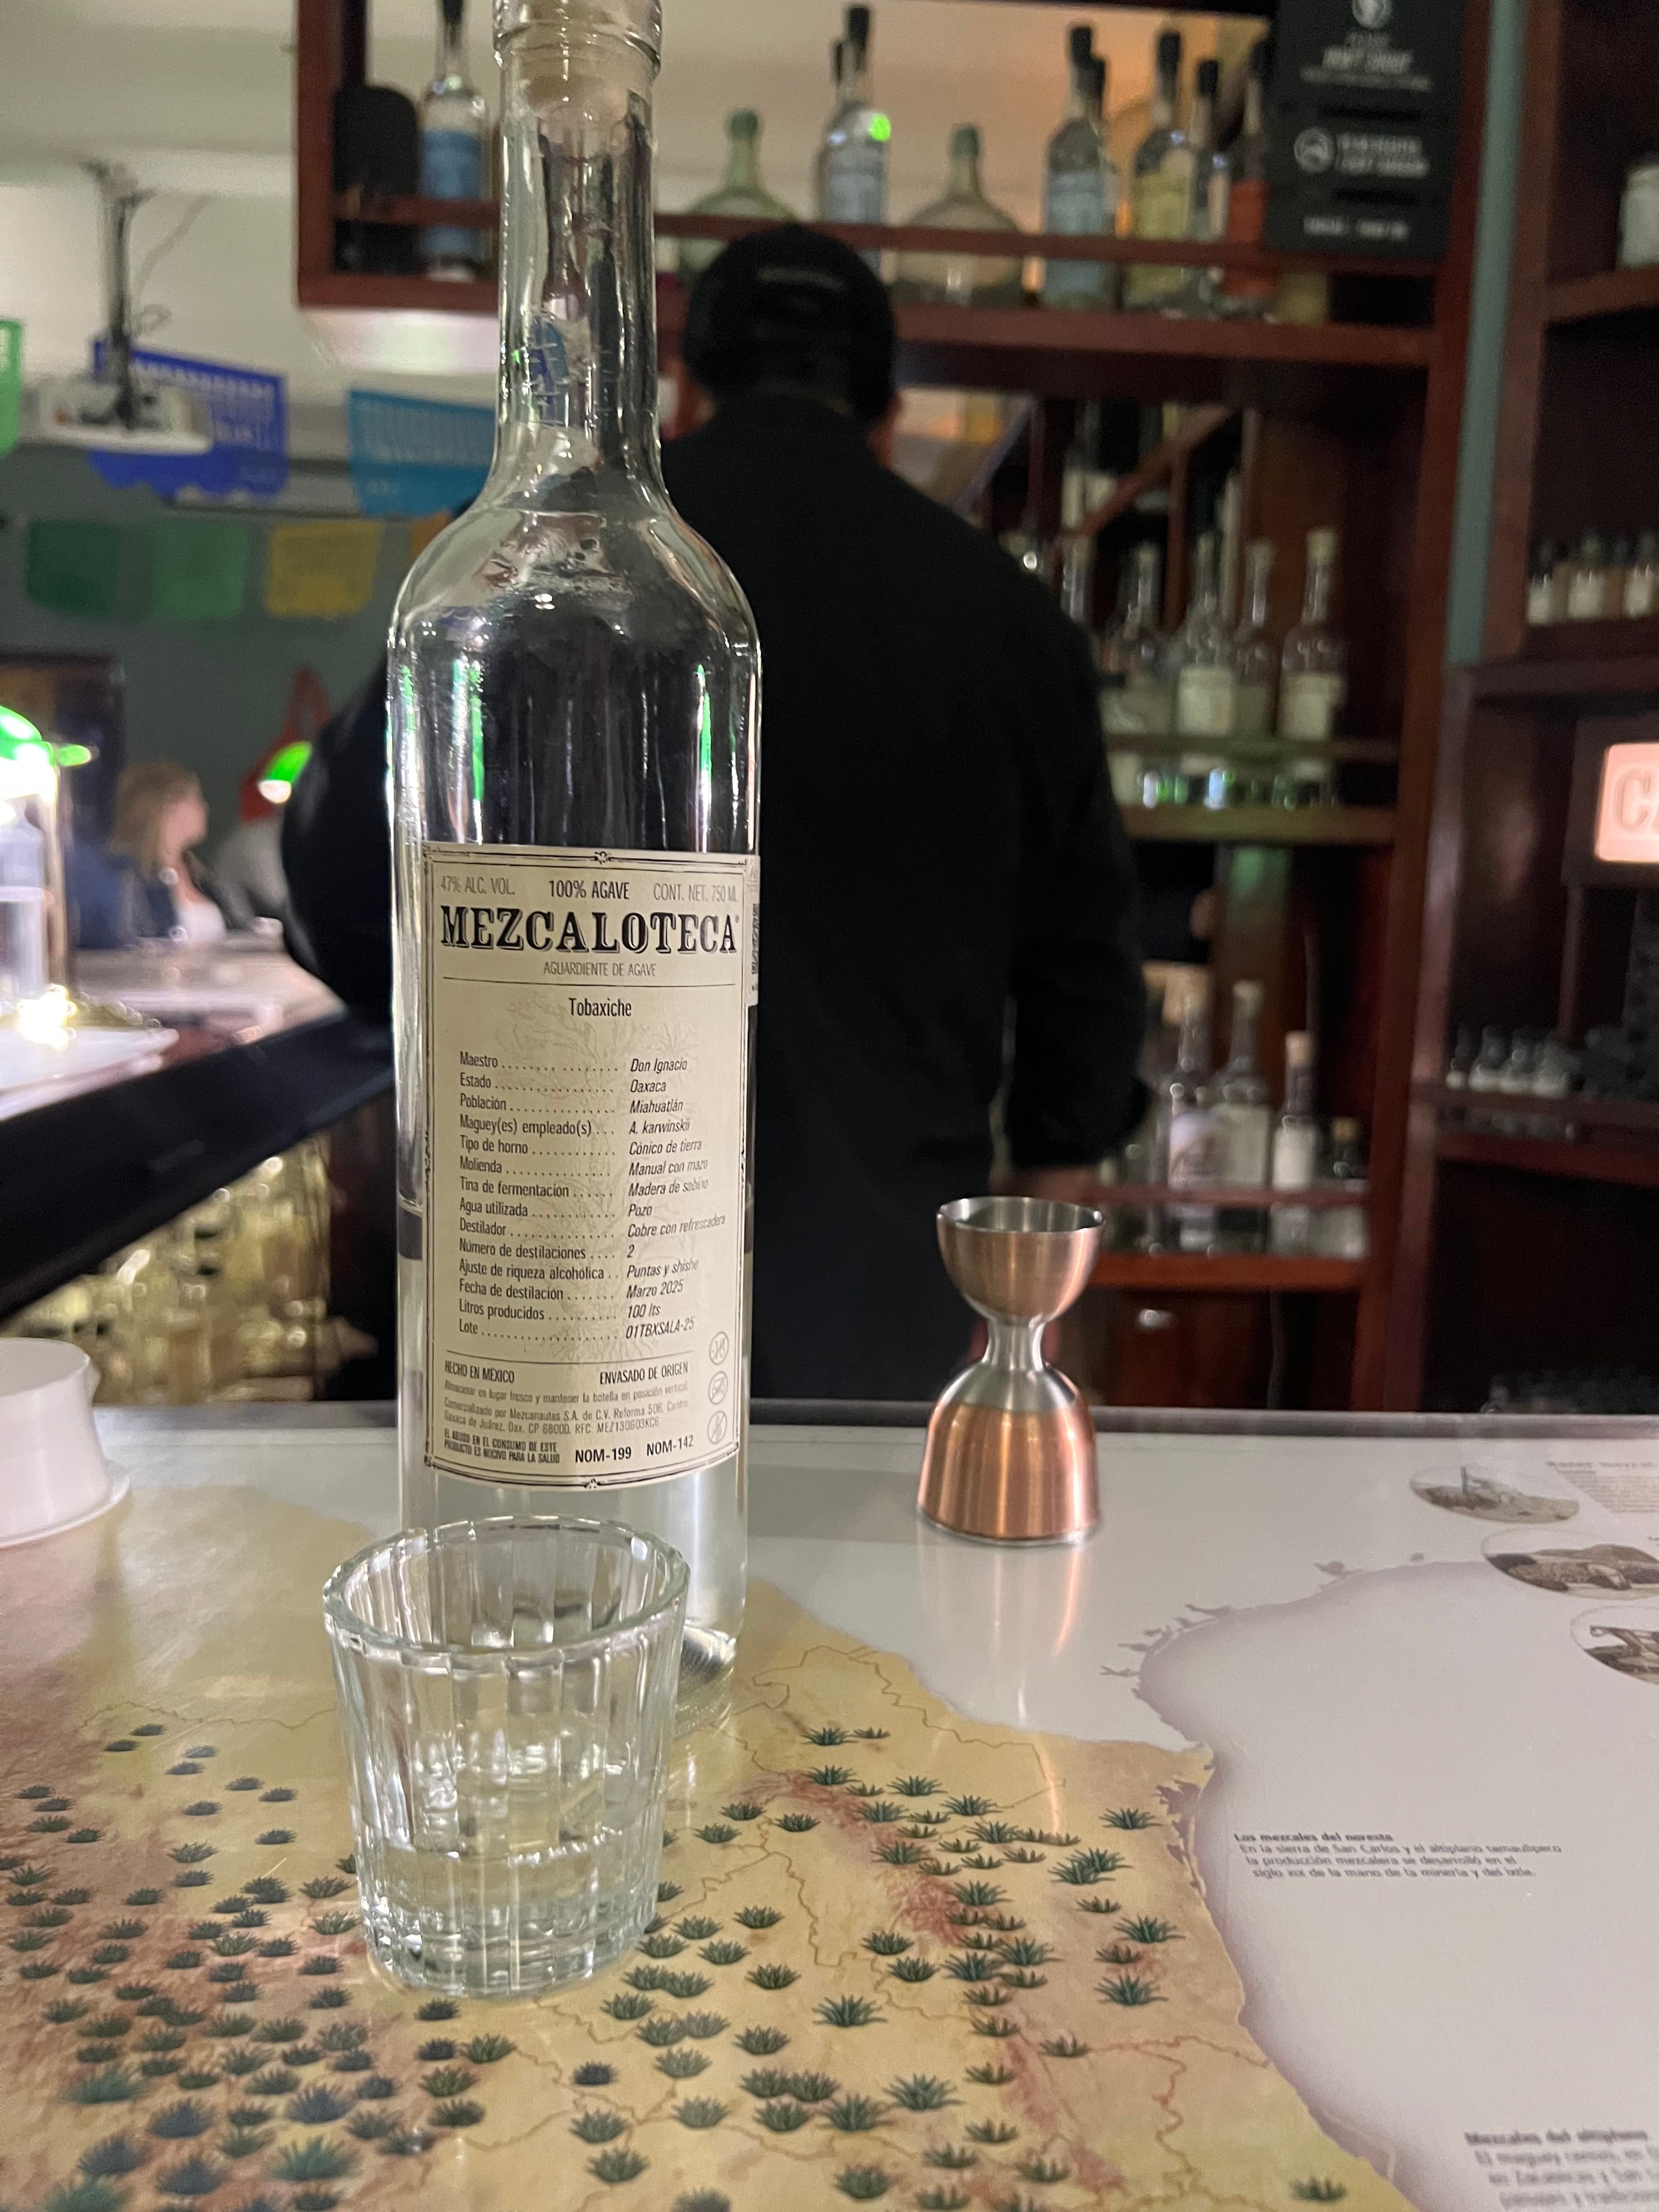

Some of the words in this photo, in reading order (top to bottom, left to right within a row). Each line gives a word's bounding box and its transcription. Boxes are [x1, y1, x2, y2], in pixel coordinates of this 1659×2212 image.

[442, 876, 461, 893] 47%
[492, 878, 515, 895] VOL.
[549, 880, 586, 898] 100%
[592, 881, 630, 900] AGAVE
[653, 883, 685, 901] CONT.
[689, 884, 708, 902] NET.
[712, 885, 726, 902] 750
[727, 886, 737, 902] ML
[441, 905, 737, 955] MEZCALOTECA
[544, 961, 608, 977] AGUARDIENTE
[612, 962, 624, 977] DE
[628, 963, 657, 977] AGAVE
[568, 997, 632, 1017] Tobaxiche
[460, 1051, 498, 1068] Maestro
[631, 1058, 650, 1072] Don
[653, 1058, 687, 1074] Ignacio
[460, 1071, 491, 1088] Estado
[630, 1079, 666, 1093] Oaxaca
[630, 1099, 683, 1113] Miahuatlán
[460, 1113, 517, 1136] Maguey(es)
[522, 1120, 591, 1138] empleado(s)
[629, 1121, 638, 1135] A.
[642, 1118, 691, 1134] karwinskii
[460, 1135, 479, 1154] Tipo
[483, 1138, 494, 1152] de
[498, 1139, 528, 1154] horno
[629, 1141, 663, 1155] Cónico
[666, 1139, 677, 1153] de
[680, 1138, 702, 1152] tierra
[460, 1155, 502, 1173] Molienda
[629, 1161, 666, 1176] Manual
[668, 1163, 685, 1173] con
[687, 1159, 708, 1172] mazo
[460, 1176, 478, 1192] Tina
[483, 1180, 494, 1194] de
[629, 1182, 665, 1197] Madera
[669, 1180, 680, 1193] de
[460, 1197, 482, 1216] Agua
[486, 1201, 528, 1216] utilizada
[628, 1203, 652, 1217] Pozo
[460, 1217, 506, 1236] Destilador
[628, 1223, 657, 1238] Cobre
[660, 1223, 676, 1235] con
[460, 1238, 495, 1255] Número
[500, 1243, 512, 1257] de
[516, 1244, 586, 1260] destilaciones
[627, 1244, 635, 1258] 2
[460, 1258, 487, 1276] Ajuste
[490, 1263, 503, 1277] de
[506, 1265, 545, 1282] riqueza
[550, 1266, 604, 1280] alcohólica
[627, 1265, 661, 1278] Puntas
[663, 1267, 669, 1277] y
[672, 1259, 699, 1273] shishe
[460, 1278, 487, 1295] Fecha
[490, 1283, 502, 1297] de
[506, 1285, 563, 1300] destilación
[627, 1284, 657, 1299] Marzo
[660, 1279, 684, 1295] 2025
[460, 1298, 484, 1315] Litros
[488, 1305, 545, 1320] producidos
[628, 1304, 646, 1319] 100
[648, 1304, 661, 1317] lts
[460, 1318, 478, 1334] Lote
[626, 1317, 696, 1339] 01TBXSALA-25
[445, 1359, 467, 1376] HECHO
[470, 1365, 479, 1379] EN
[483, 1367, 515, 1383] MÉXICO
[600, 1368, 645, 1384] ENVASADO
[648, 1367, 658, 1380] DE
[661, 1362, 689, 1378] ORIGEN
[478, 1388, 487, 1397] en
[489, 1389, 506, 1402] lugar
[510, 1390, 533, 1403] fresco
[535, 1395, 540, 1404] y
[543, 1394, 579, 1403] mantener
[583, 1392, 590, 1403] la
[593, 1392, 618, 1402] botella
[621, 1391, 630, 1400] en
[633, 1386, 662, 1401] posición
[495, 1409, 506, 1418] por
[564, 1410, 579, 1421] S.A.
[583, 1410, 592, 1420] de
[596, 1409, 611, 1420] C.V.
[614, 1406, 645, 1418] Reforma
[469, 1416, 477, 1427] de
[528, 1423, 539, 1434] CP
[444, 1428, 450, 1438] EL
[473, 1435, 480, 1445] EN
[483, 1437, 489, 1447] EL
[493, 1438, 526, 1451] CONSUMO
[529, 1442, 537, 1452] DE
[541, 1442, 557, 1453] ESTE
[575, 1447, 631, 1463] NOM-199
[647, 1435, 693, 1457] NOM-142
[474, 1448, 481, 1457] ES
[483, 1450, 506, 1460] NOCIVO
[509, 1452, 525, 1462] PARA
[528, 1454, 536, 1463] LA
[539, 1454, 560, 1464] SALUD
[1234, 1833, 1257, 1841] Los
[1260, 1832, 1318, 1842] mezcales
[1321, 1832, 1342, 1842] del
[1345, 1833, 1393, 1842] noreste
[1240, 1845, 1257, 1853] En
[1260, 1844, 1272, 1853] la
[1276, 1844, 1310, 1853] sierra
[1314, 1844, 1330, 1853] de
[1332, 1844, 1357, 1853] San
[1360, 1843, 1401, 1853] Carlos
[1403, 1846, 1410, 1854] y
[1414, 1844, 1425, 1853] el
[1246, 1855, 1259, 1865] la
[1262, 1856, 1331, 1866] producción
[1336, 1855, 1398, 1865] mezcalera
[1505, 1855, 1516, 1865] el
[1252, 1869, 1283, 1878] siglo
[1310, 1868, 1325, 1877] de
[1328, 1868, 1342, 1877] la
[1345, 1869, 1381, 1877] mano
[1385, 1868, 1401, 1877] de
[1404, 1868, 1418, 1877] la
[1471, 1870, 1479, 1878] y
[1483, 1867, 1503, 1877] del
